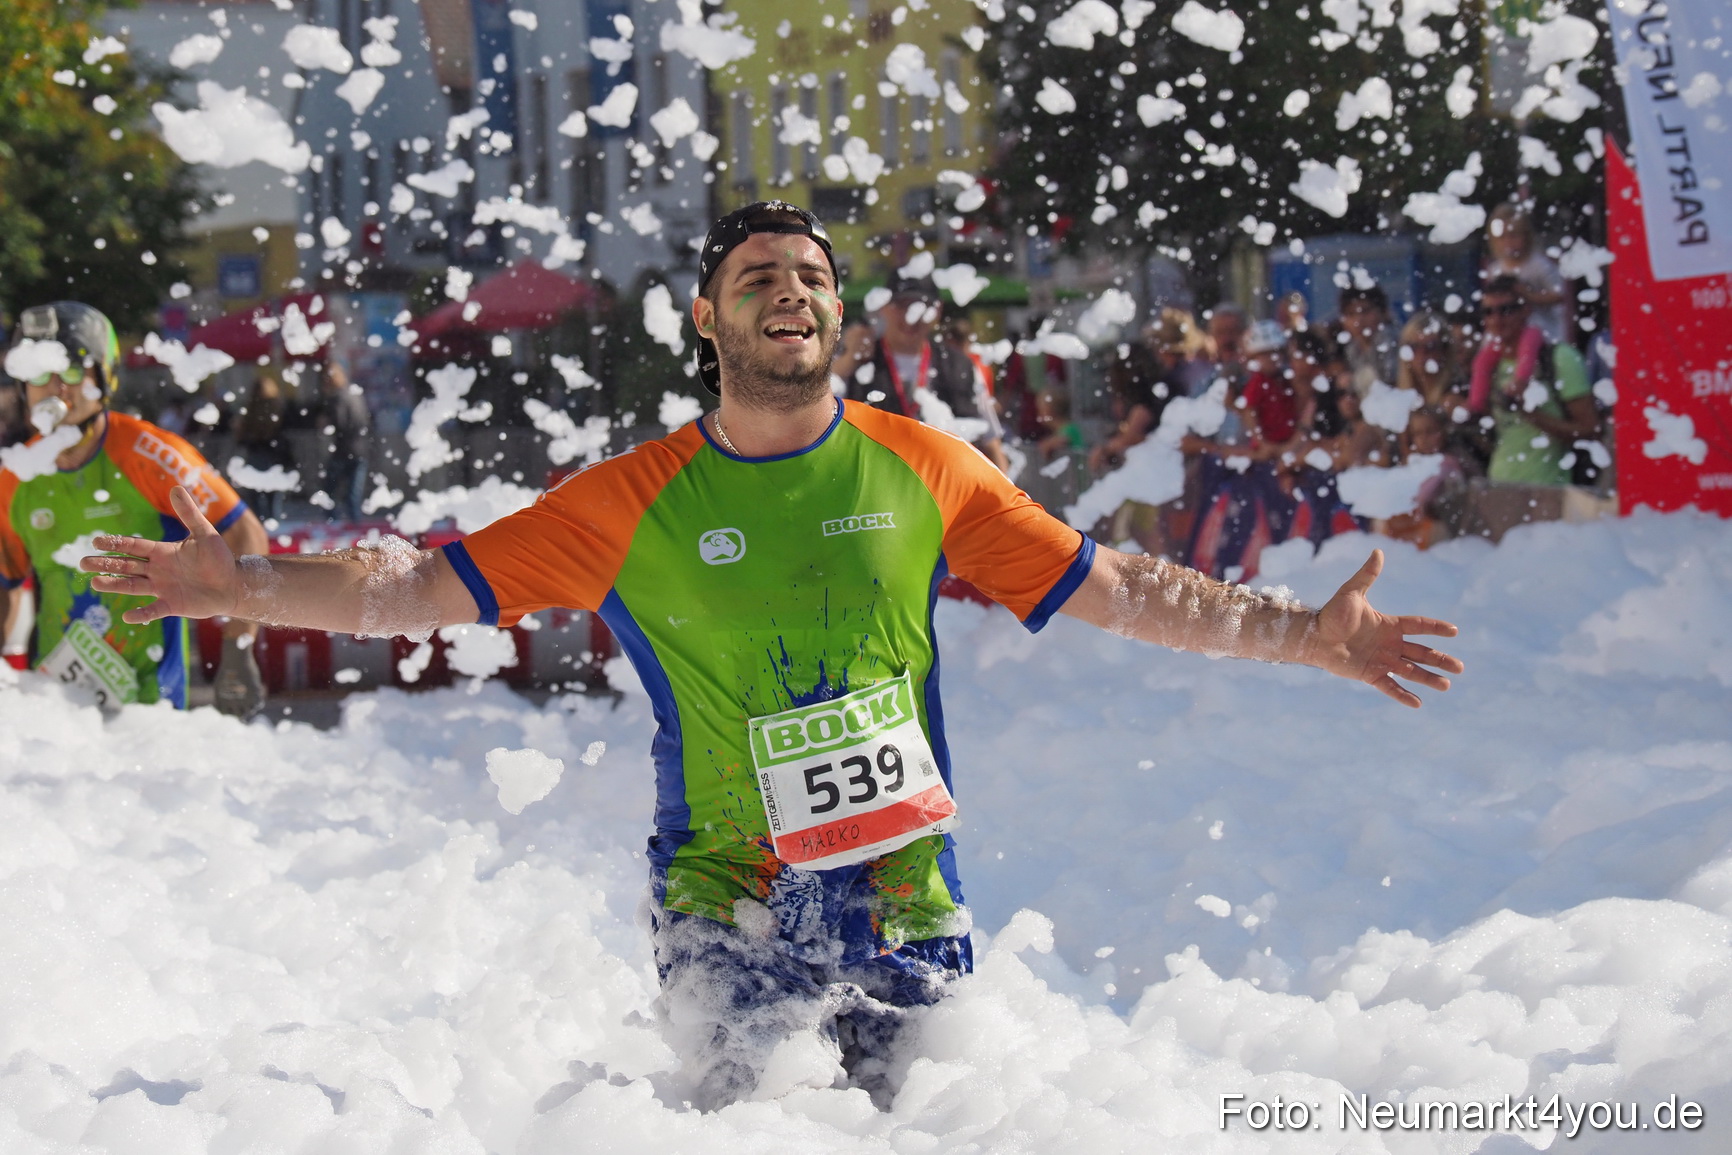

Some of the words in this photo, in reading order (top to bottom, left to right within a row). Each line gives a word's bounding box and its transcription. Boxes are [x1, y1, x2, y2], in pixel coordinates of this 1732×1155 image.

[823, 513, 895, 535] BOCK
[765, 686, 903, 758] BOCK
[803, 743, 905, 815] 539
[801, 824, 861, 856] MARKO
[931, 823, 944, 833] XL
